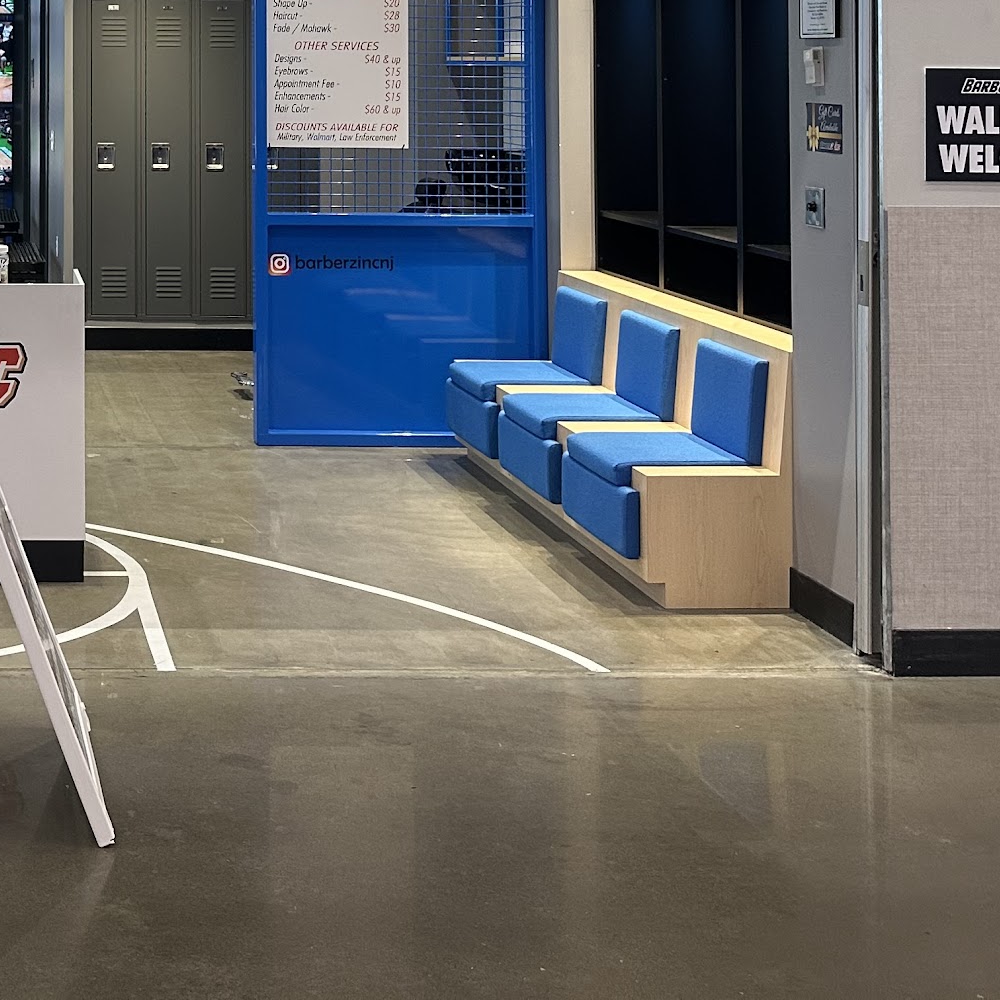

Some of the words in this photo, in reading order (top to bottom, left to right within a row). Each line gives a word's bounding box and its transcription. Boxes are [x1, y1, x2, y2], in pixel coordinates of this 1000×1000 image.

[297, 0, 308, 9] Up
[273, 11, 298, 20] Haircut
[384, 11, 400, 21] $28
[273, 24, 290, 33] Fade
[301, 24, 332, 33] Mohawk
[384, 23, 400, 33] $30
[294, 42, 327, 50] OTHER
[331, 42, 379, 50] SERVICES
[275, 54, 301, 64] Designs
[365, 54, 380, 64] $40
[383, 55, 389, 63] &
[392, 56, 400, 65] up
[275, 66, 308, 77] Eyebrows
[385, 67, 401, 77] $15
[274, 79, 320, 90] Appointment
[321, 79, 334, 88] Fee
[385, 79, 401, 89] $10
[275, 92, 326, 101] Enhancements
[385, 92, 401, 102] $15
[275, 104, 289, 113] Hair
[291, 104, 309, 113] Color
[365, 105, 380, 114] $60
[383, 105, 389, 114] &
[392, 107, 400, 115] up
[275, 123, 327, 131] DISCOUNTS
[330, 123, 376, 131] AVAILABLE
[277, 133, 304, 142] Military,
[307, 133, 337, 142] Walmart,
[355, 133, 396, 142] Enforcement
[938, 144, 1000, 173] WEL
[296, 255, 394, 272] barberzincnj
